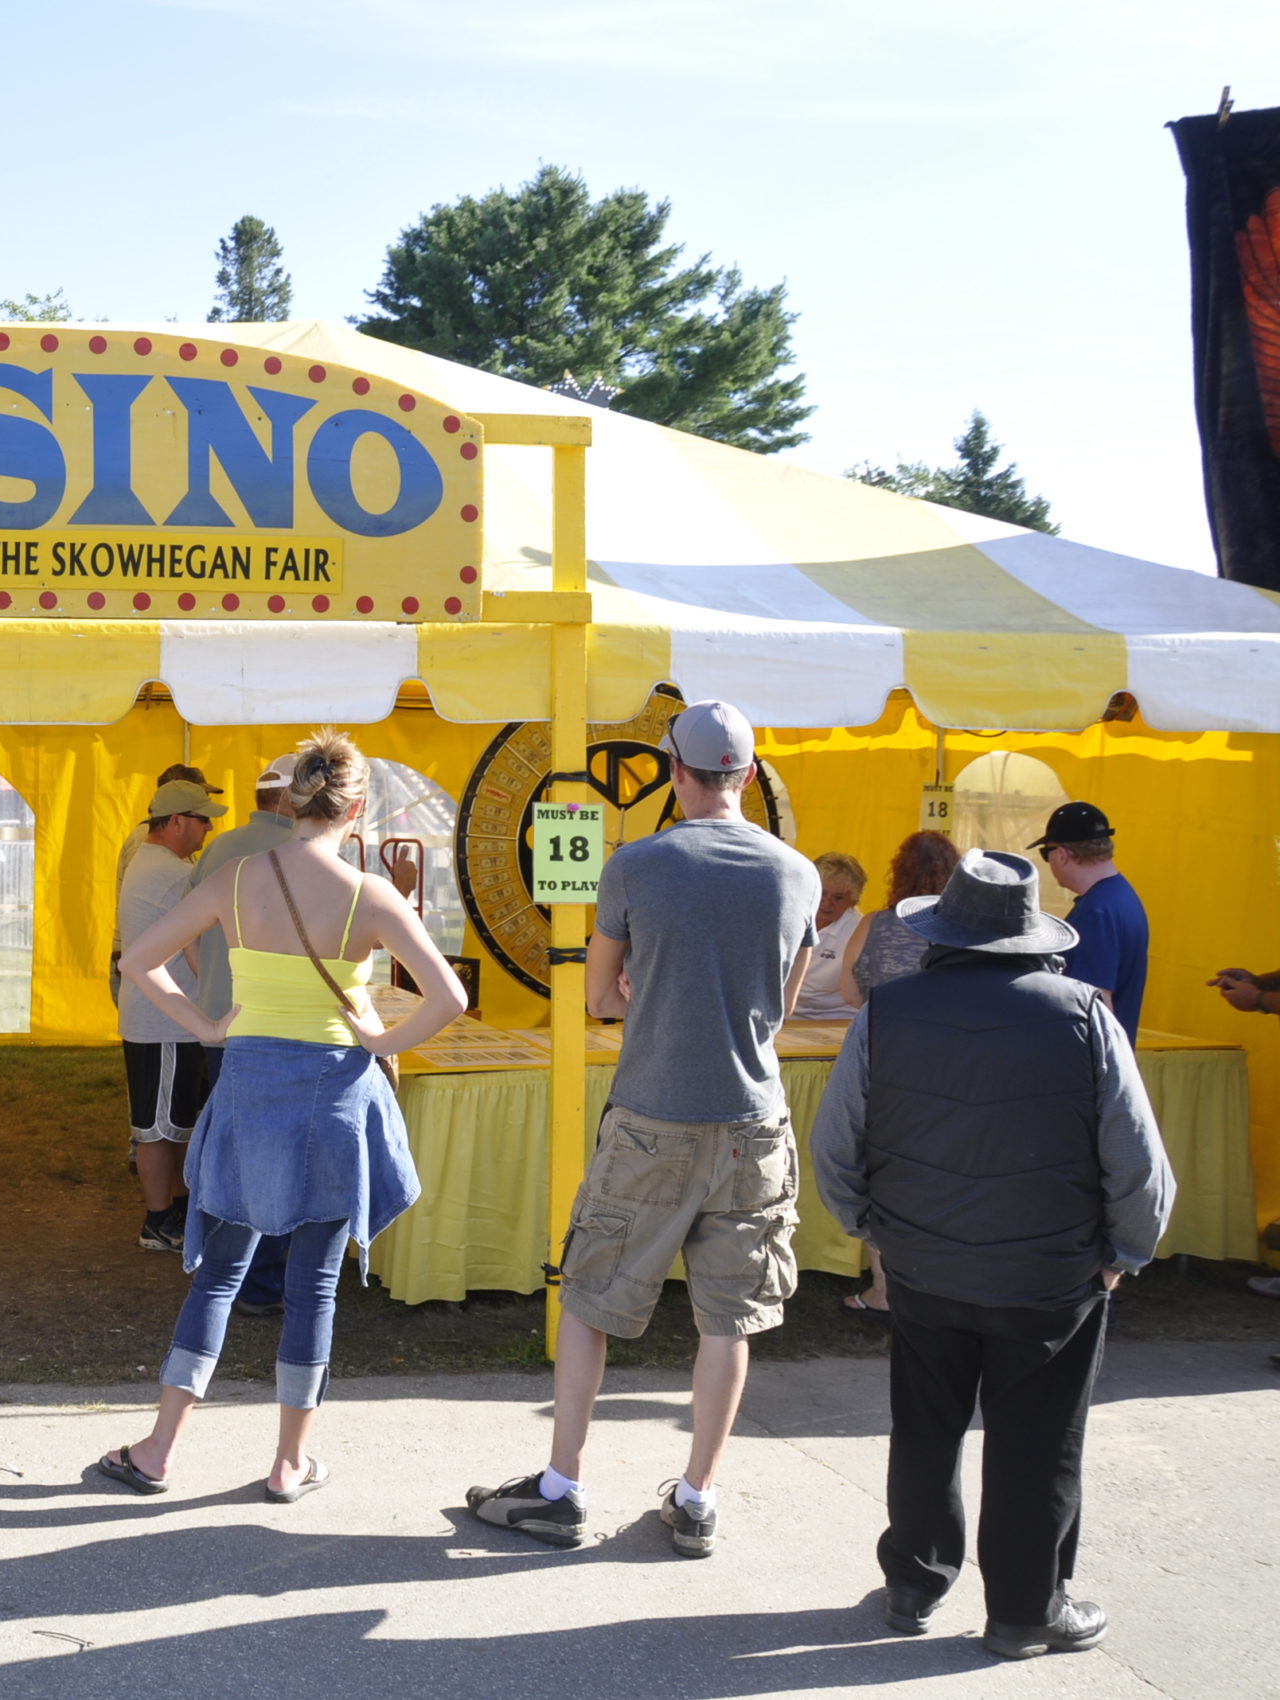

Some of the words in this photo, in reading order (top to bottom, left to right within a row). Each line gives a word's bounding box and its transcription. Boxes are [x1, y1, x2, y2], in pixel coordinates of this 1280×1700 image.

[52, 542, 251, 580] SKOWHEGAN
[264, 547, 331, 583] FAIR
[537, 809, 576, 820] MUST
[579, 811, 599, 821] BE
[928, 801, 948, 818] 18
[549, 835, 590, 862] 18
[537, 880, 557, 890] TO
[561, 881, 598, 891] PLAY
